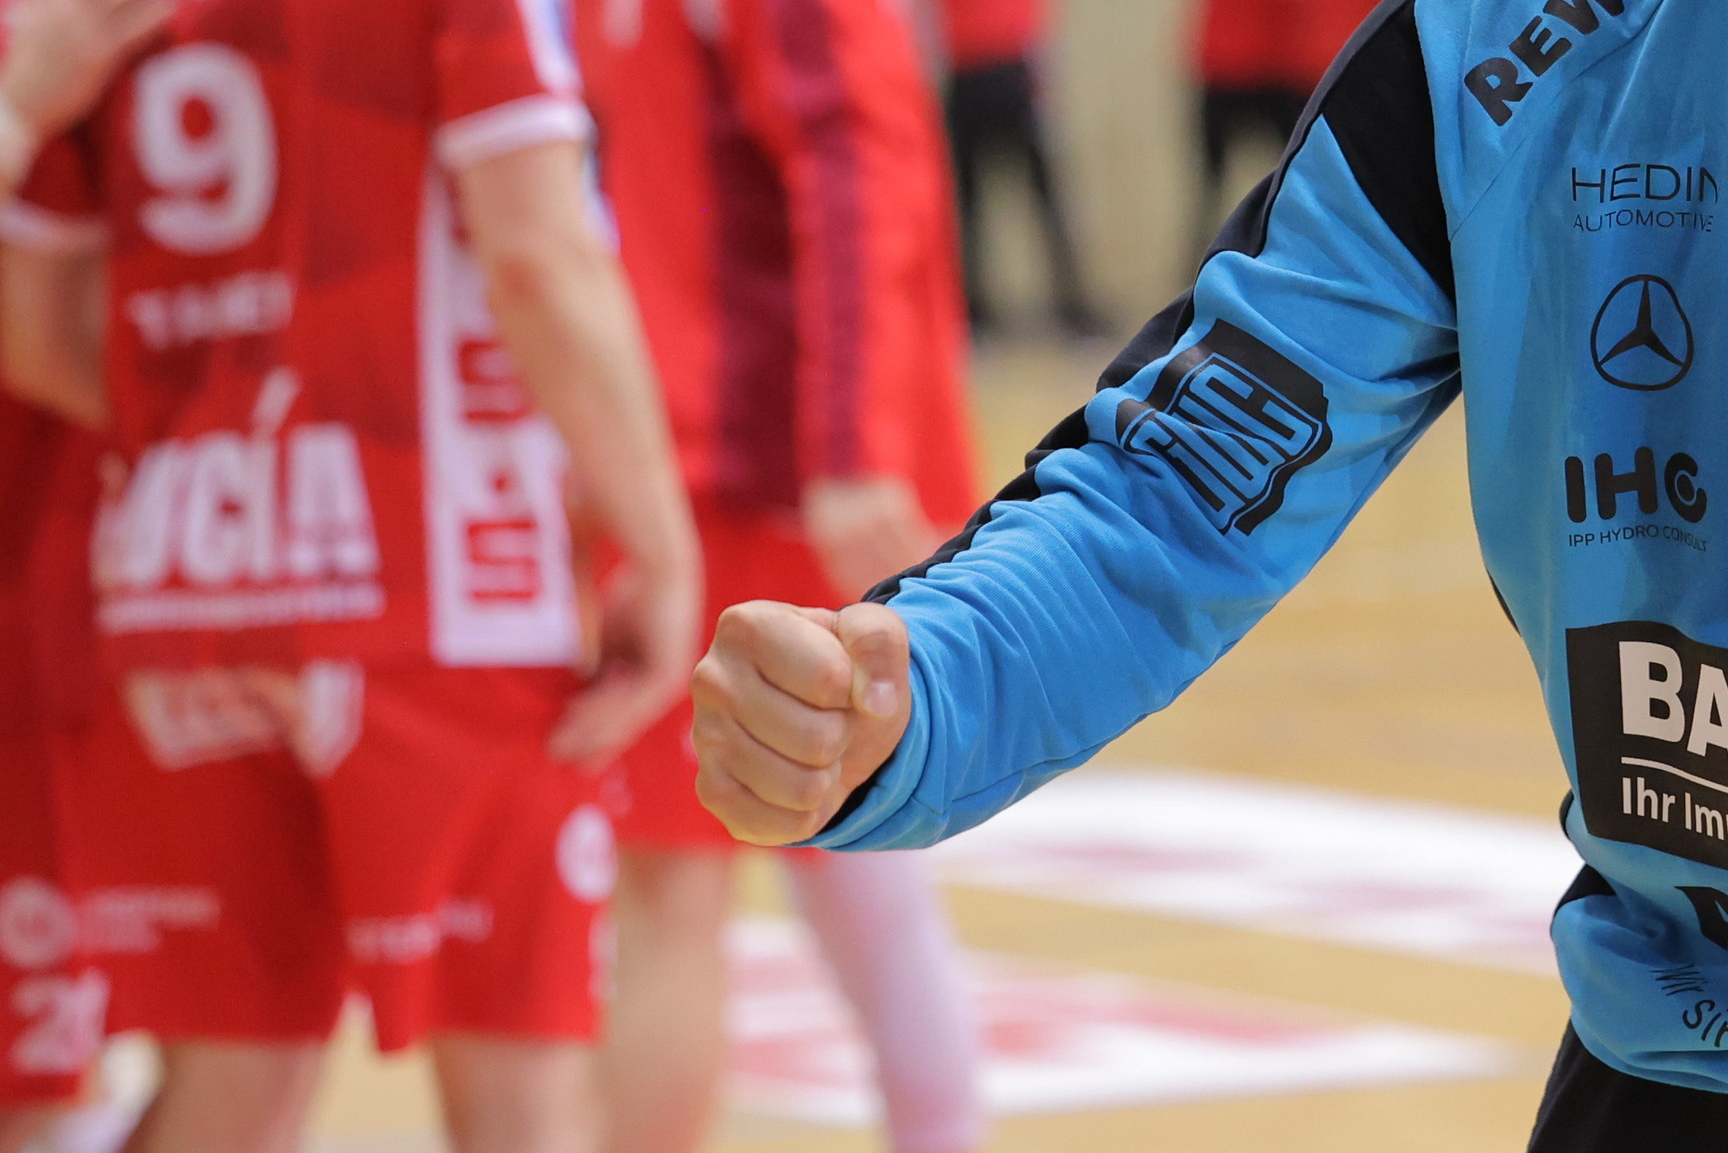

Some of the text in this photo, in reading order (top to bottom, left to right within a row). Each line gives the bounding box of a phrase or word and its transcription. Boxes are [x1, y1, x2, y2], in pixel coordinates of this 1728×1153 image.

[133, 43, 278, 250] 9
[1573, 209, 1714, 233] AUTOMOTIVE
[1564, 446, 1707, 524] IHC
[1569, 524, 1707, 552] IPP HYDRO CONSULT
[1621, 776, 1676, 823] Ihr
